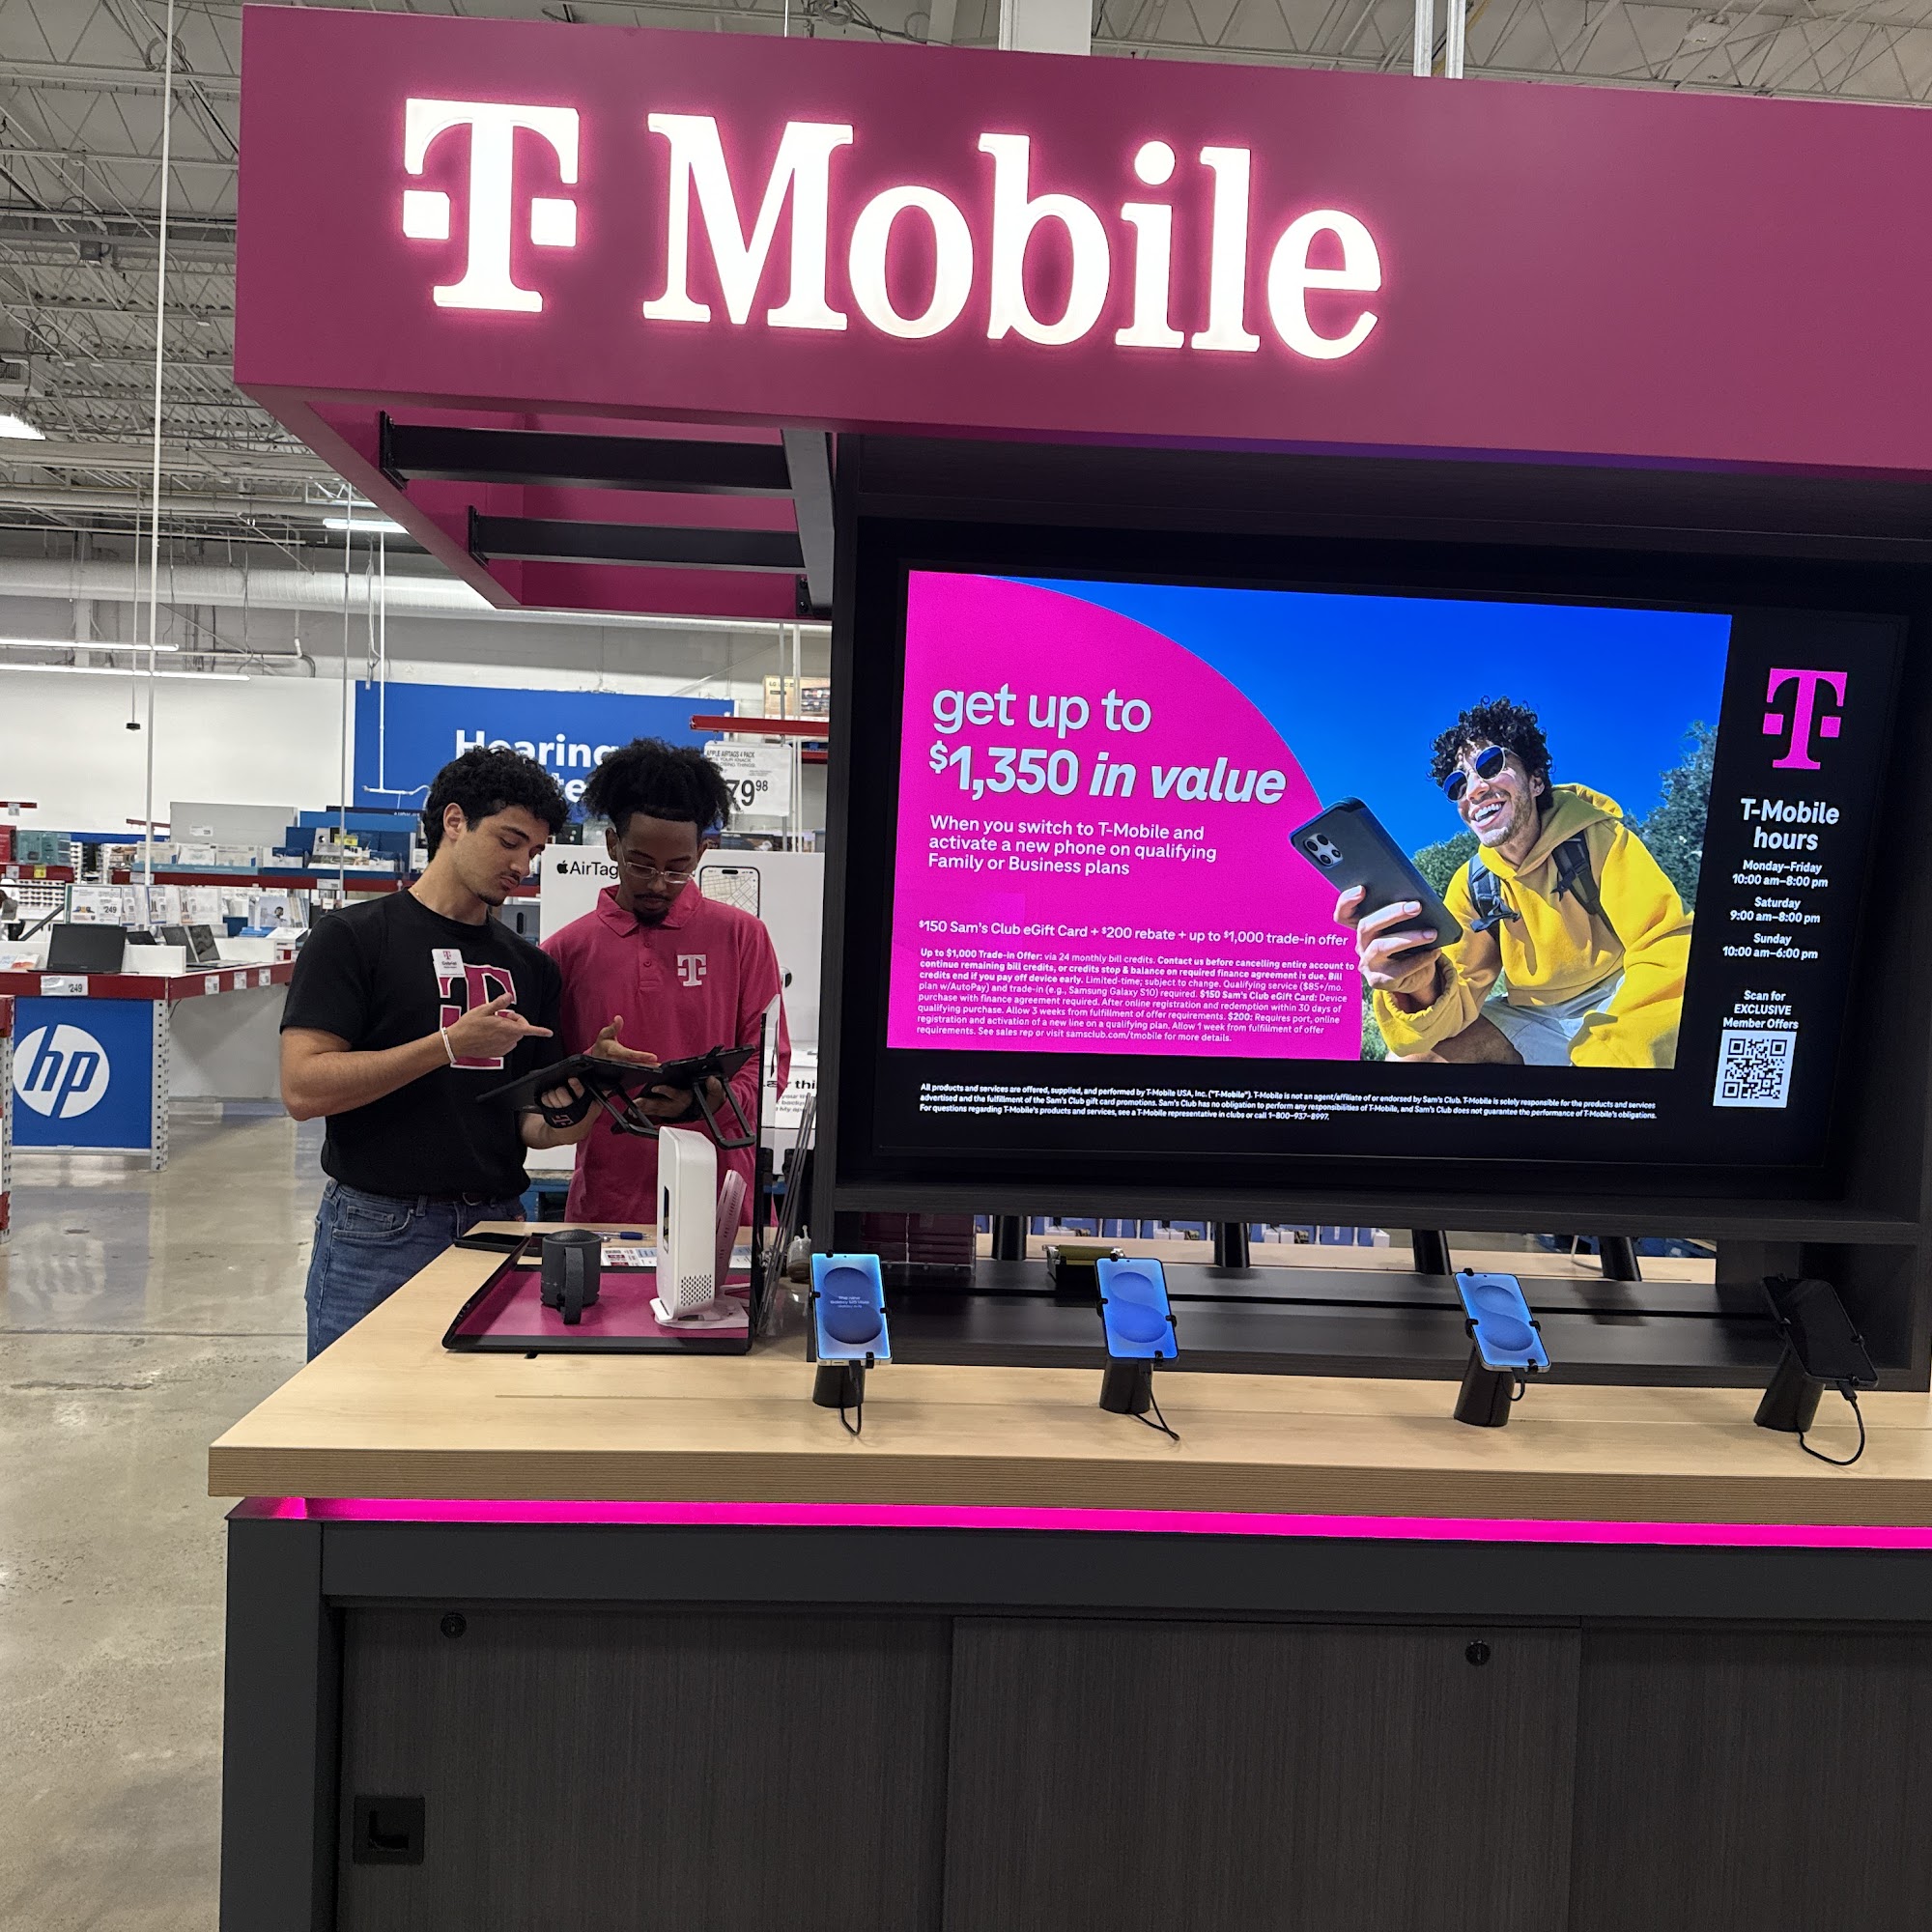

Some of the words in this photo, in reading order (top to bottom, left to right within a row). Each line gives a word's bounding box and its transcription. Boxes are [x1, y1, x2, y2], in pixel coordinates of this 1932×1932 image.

[403, 98, 580, 313] T
[642, 113, 1382, 360] Mobile
[932, 683, 1016, 734] get
[1028, 695, 1090, 738] up
[1101, 689, 1151, 732] to
[928, 740, 1079, 801] $1,350
[1089, 752, 1137, 798] in
[1151, 756, 1288, 804] value
[1741, 798, 1839, 824] T-Mobile
[929, 814, 980, 831] When
[983, 820, 1013, 835] you
[1018, 818, 1072, 835] switch
[1076, 822, 1094, 836] to
[1097, 821, 1169, 838] T-Mobile
[1173, 825, 1204, 839] and
[928, 834, 997, 850] activate
[1001, 840, 1010, 850] a
[1015, 840, 1050, 852] new
[1054, 838, 1106, 857] phone
[1109, 844, 1130, 856] on
[1134, 842, 1216, 862] qualifying
[1753, 826, 1818, 850] hours
[928, 853, 983, 871] Family
[987, 859, 1005, 869] or
[1009, 856, 1081, 872] Business
[1085, 859, 1129, 876] plans
[1743, 860, 1822, 874] Monday–Friday
[1732, 873, 1762, 884] 10:00
[1762, 874, 1810, 886] am–8:00
[1810, 879, 1828, 889] pm
[1754, 896, 1801, 909] Saturday
[1729, 910, 1754, 921] 9:00
[1755, 911, 1803, 922] am–8:00
[1803, 915, 1820, 924] pm
[918, 920, 948, 931] $150
[950, 921, 988, 933] Sam's
[990, 923, 1021, 934] Club
[1022, 923, 1055, 935] eGift
[1057, 924, 1088, 936] Card
[1101, 926, 1132, 938] $200
[1134, 927, 1176, 939] rebate
[1188, 932, 1206, 943] up
[1208, 931, 1221, 941] to
[1223, 930, 1264, 944] $1,000
[1265, 932, 1316, 944] trade-in
[1318, 933, 1349, 945] offer
[1752, 932, 1792, 946] Sunday
[920, 948, 933, 957] Up
[946, 949, 977, 958] $1,000
[978, 950, 1015, 958] Trade-in
[1016, 951, 1042, 959] Offer:
[1071, 953, 1107, 963] monthly
[1157, 955, 1192, 964] Contact
[1205, 957, 1234, 966] before
[1235, 958, 1280, 969] cancelling
[1722, 946, 1752, 956] 10:00
[1752, 947, 1800, 957] am–6:00
[1801, 951, 1818, 960] pm
[677, 954, 706, 986] T
[919, 970, 951, 979] credits
[952, 971, 969, 980] end
[1059, 975, 1083, 983] early.
[1086, 976, 1142, 985] Limited-time;
[1144, 978, 1176, 987] subject
[1188, 980, 1221, 988] change.
[1223, 980, 1265, 990] Qualifying
[1299, 981, 1344, 992] ($85+/mo.
[918, 992, 958, 1002] purchase
[980, 994, 1012, 1003] finance
[1013, 996, 1061, 1006] agreement
[1062, 997, 1099, 1007] required.
[1151, 1000, 1202, 1009] registration
[1220, 1001, 1268, 1011] redemption
[1311, 1005, 1331, 1013] days
[1743, 989, 1769, 1000] Scan
[1770, 990, 1786, 1001] for
[1733, 1003, 1792, 1014] EXCLUSIVE
[1722, 1017, 1766, 1028] Member
[1766, 1018, 1799, 1028] Offers
[21, 1024, 100, 1119] hp
